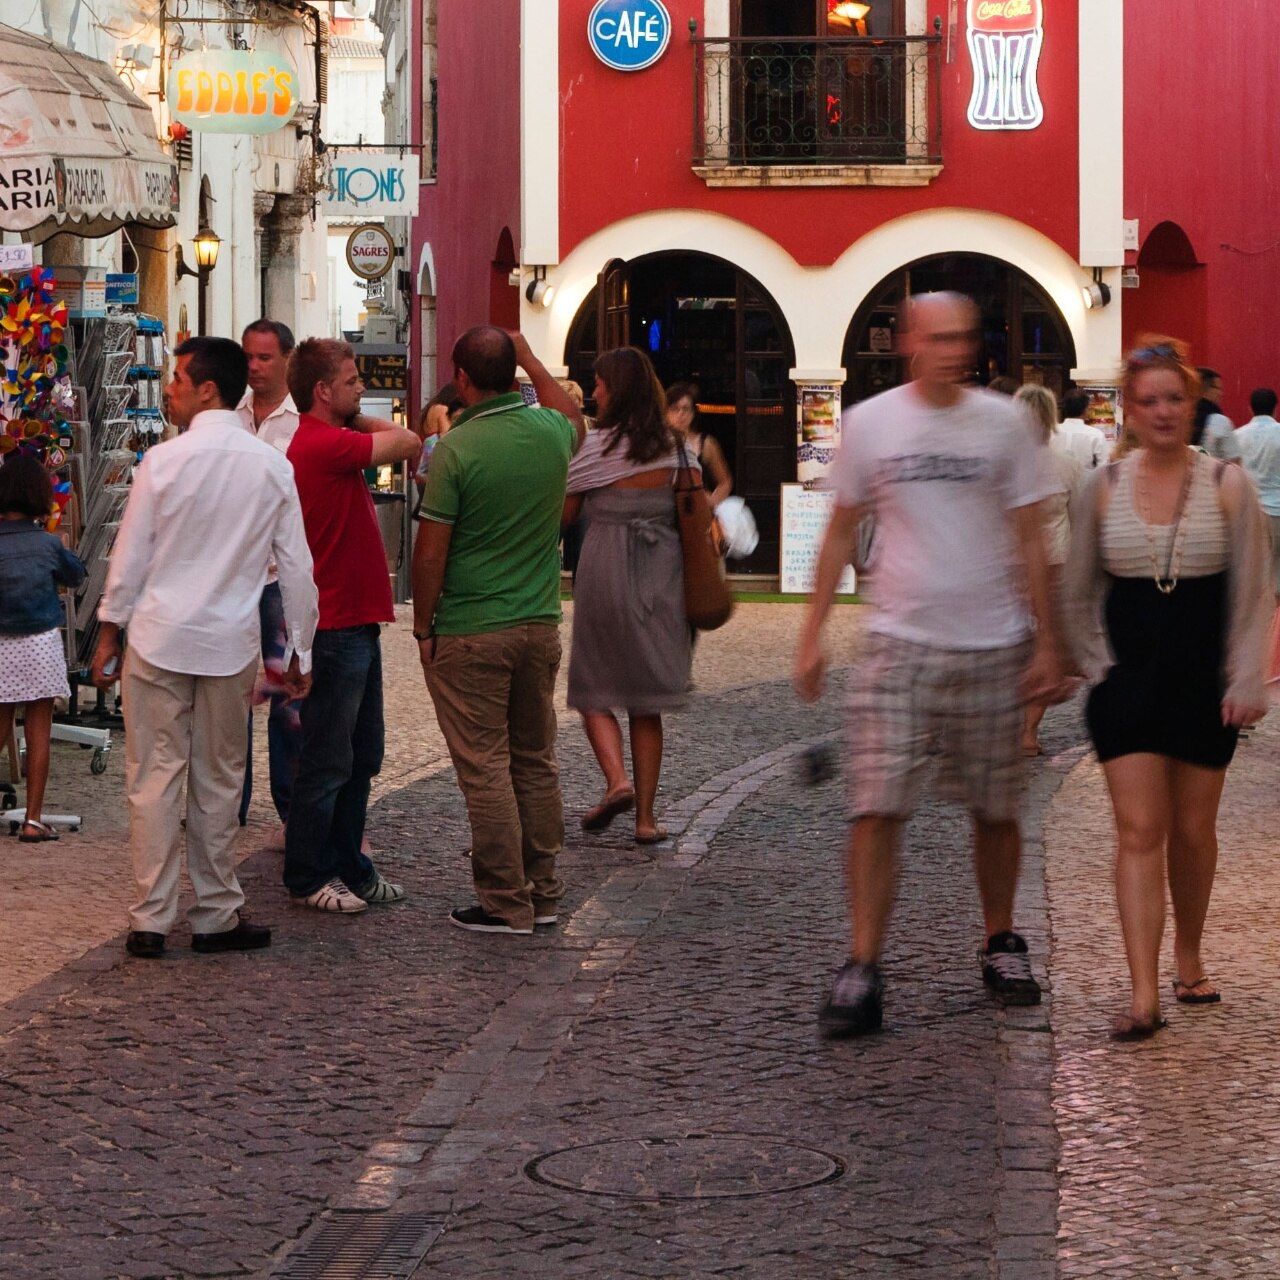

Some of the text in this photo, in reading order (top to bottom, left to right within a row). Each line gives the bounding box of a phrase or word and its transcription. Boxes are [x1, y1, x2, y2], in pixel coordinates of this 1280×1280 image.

[595, 10, 660, 49] CAFÉ
[176, 65, 293, 117] EDDIE'S
[327, 167, 406, 203] STONES
[352, 245, 389, 258] SAGRES
